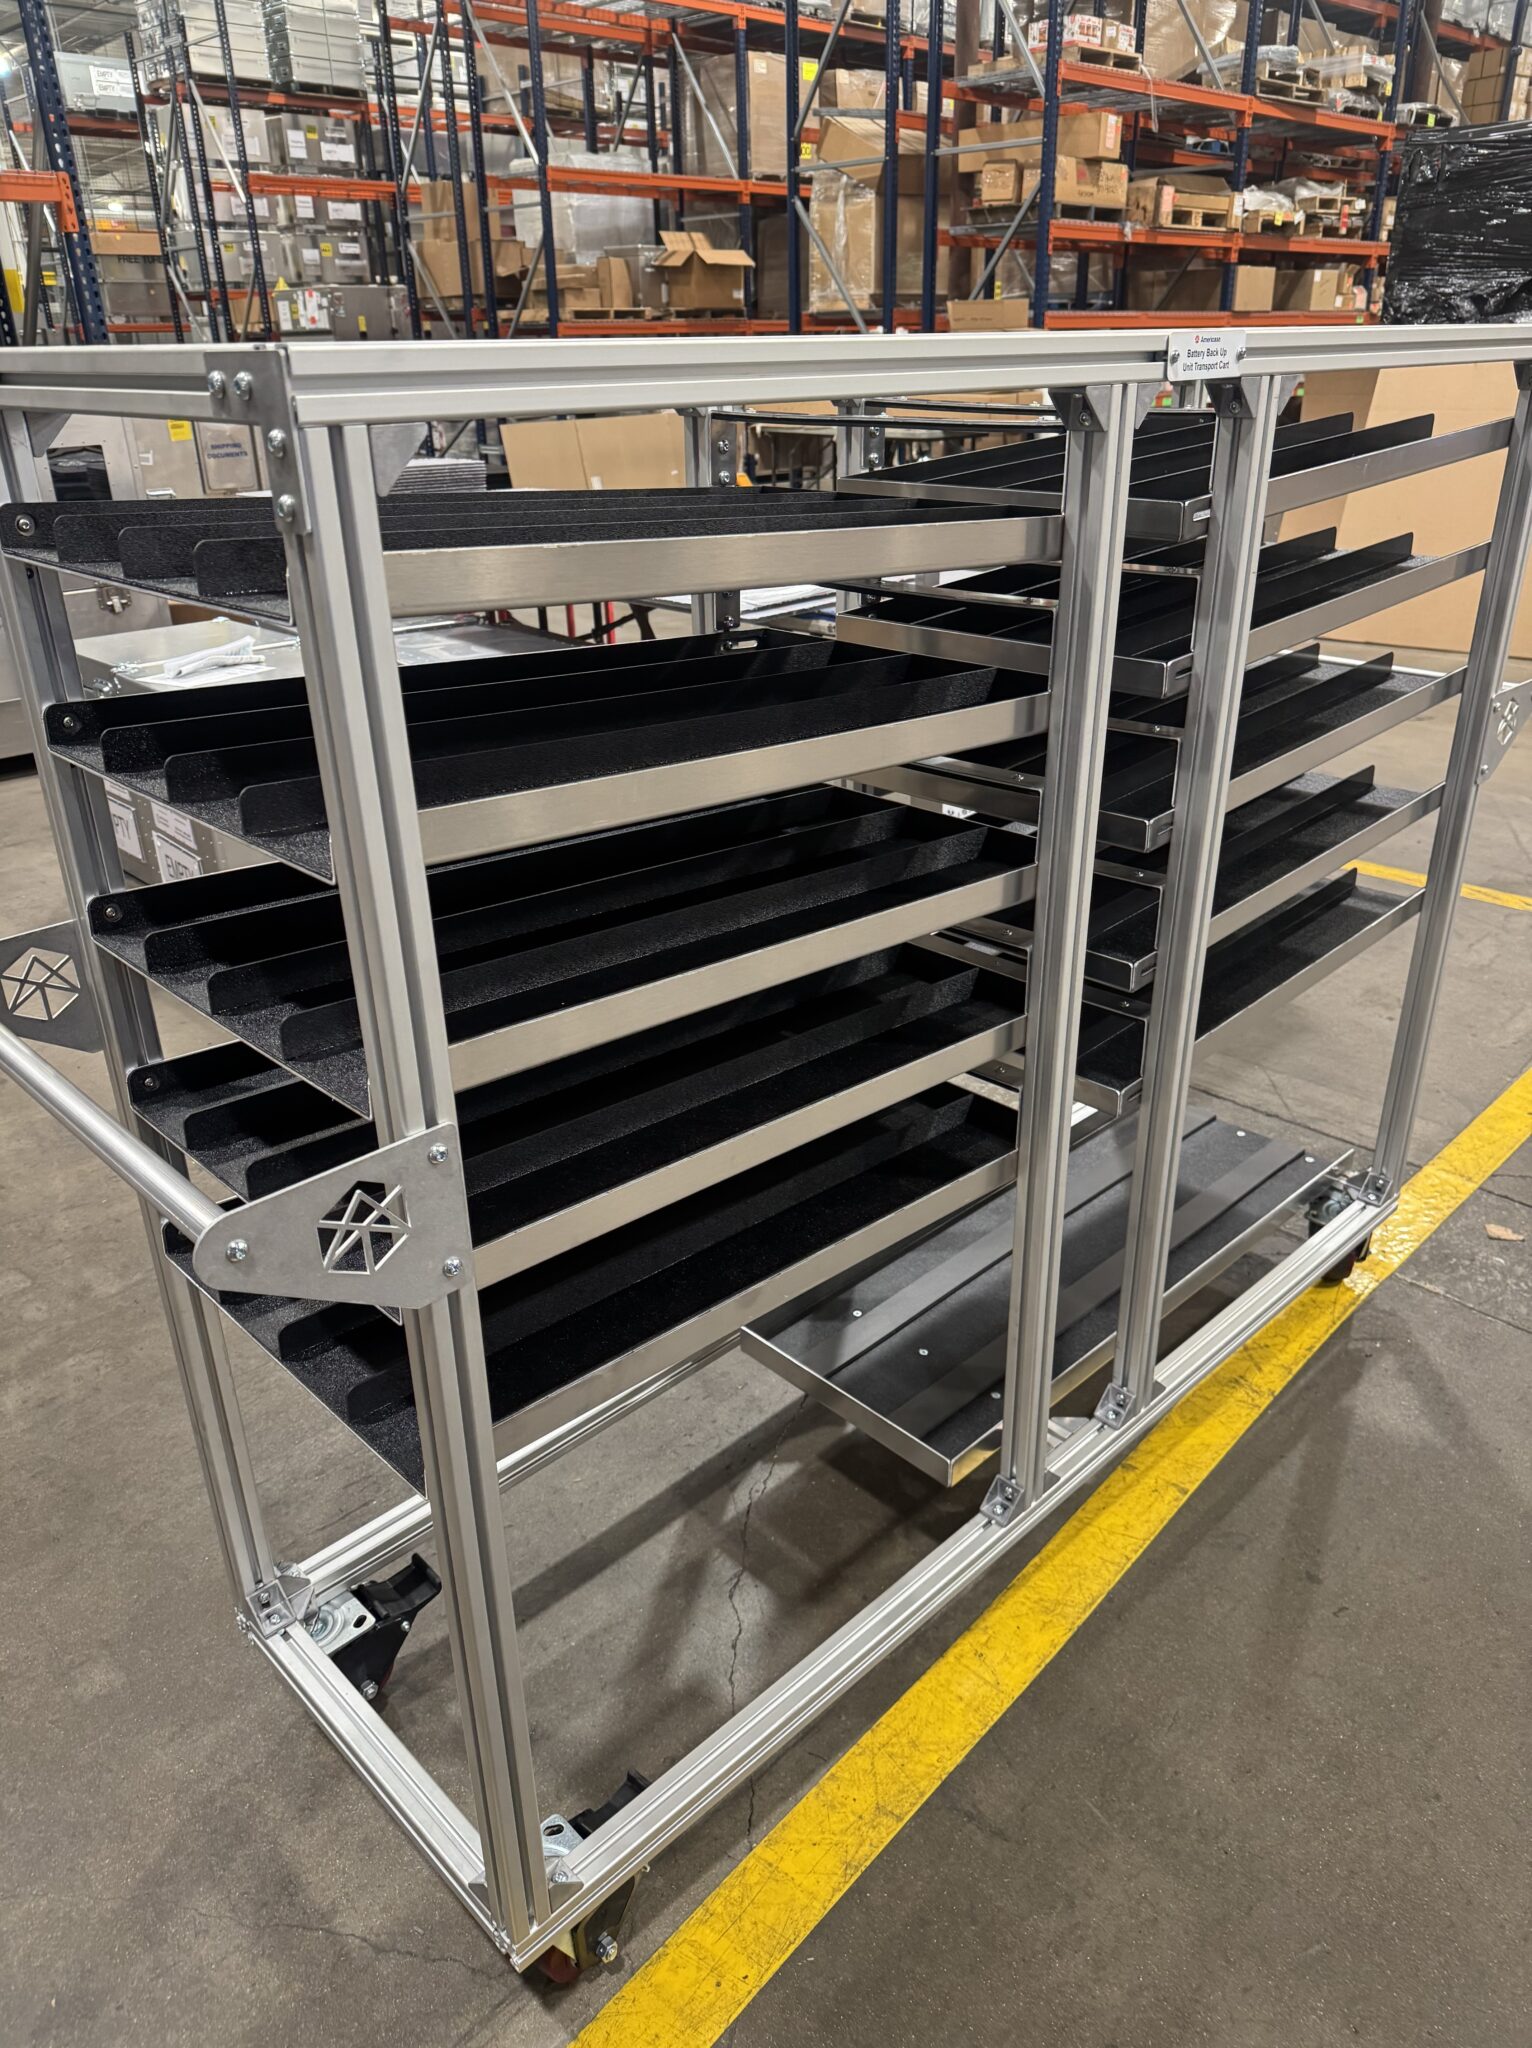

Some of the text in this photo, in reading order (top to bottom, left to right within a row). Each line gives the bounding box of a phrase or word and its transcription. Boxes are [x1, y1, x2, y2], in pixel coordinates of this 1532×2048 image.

[1187, 347, 1228, 359] Battery Back Up
[1183, 360, 1230, 372] Unit Transport Cart
[207, 451, 248, 459] DOCUMENTS
